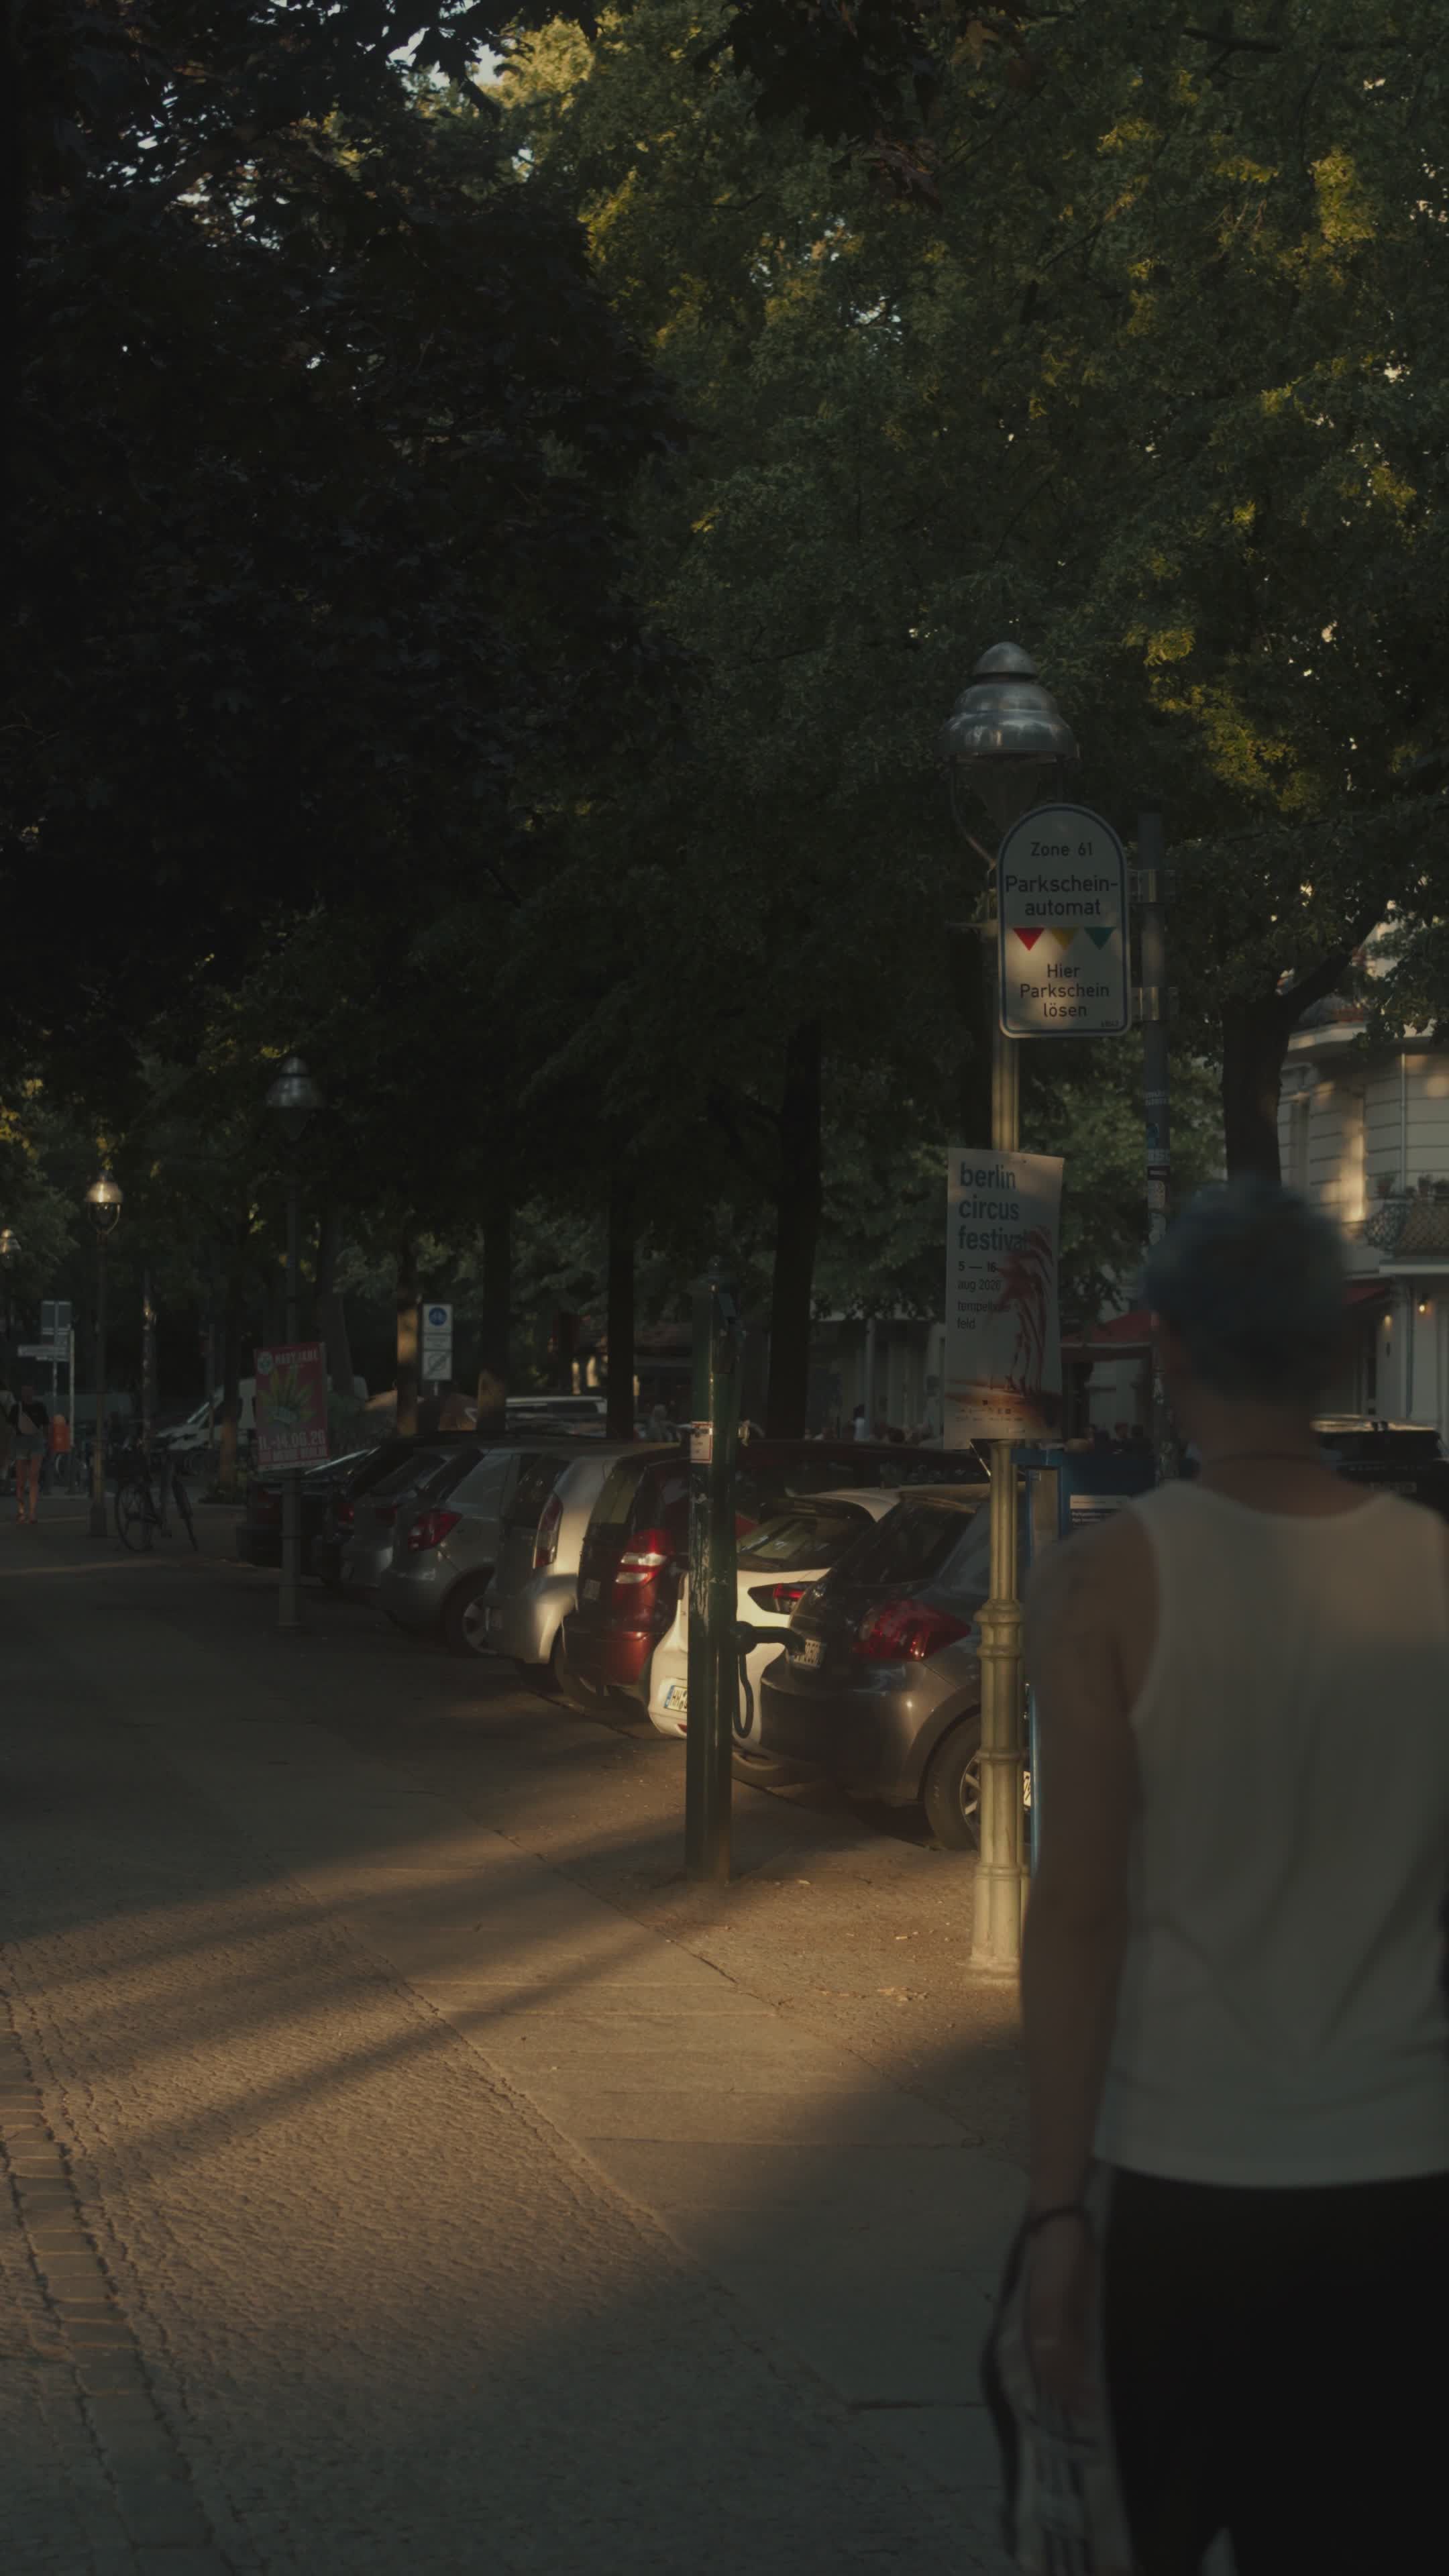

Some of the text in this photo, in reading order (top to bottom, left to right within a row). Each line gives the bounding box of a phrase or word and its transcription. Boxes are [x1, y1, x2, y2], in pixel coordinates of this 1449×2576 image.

[1030, 842, 1093, 857] Zone 61
[1005, 874, 1118, 892] Parkschein-
[1024, 899, 1102, 916] automat
[1046, 963, 1081, 978] Hier
[1020, 983, 1110, 998] Parkschein
[1043, 1003, 1087, 1017] lösen
[960, 1161, 1016, 1189] berlin
[958, 1194, 1020, 1220] circus
[958, 1225, 1030, 1251] festival
[958, 1261, 965, 1272] 5
[957, 1280, 976, 1293] aug
[957, 1318, 976, 1330] feld
